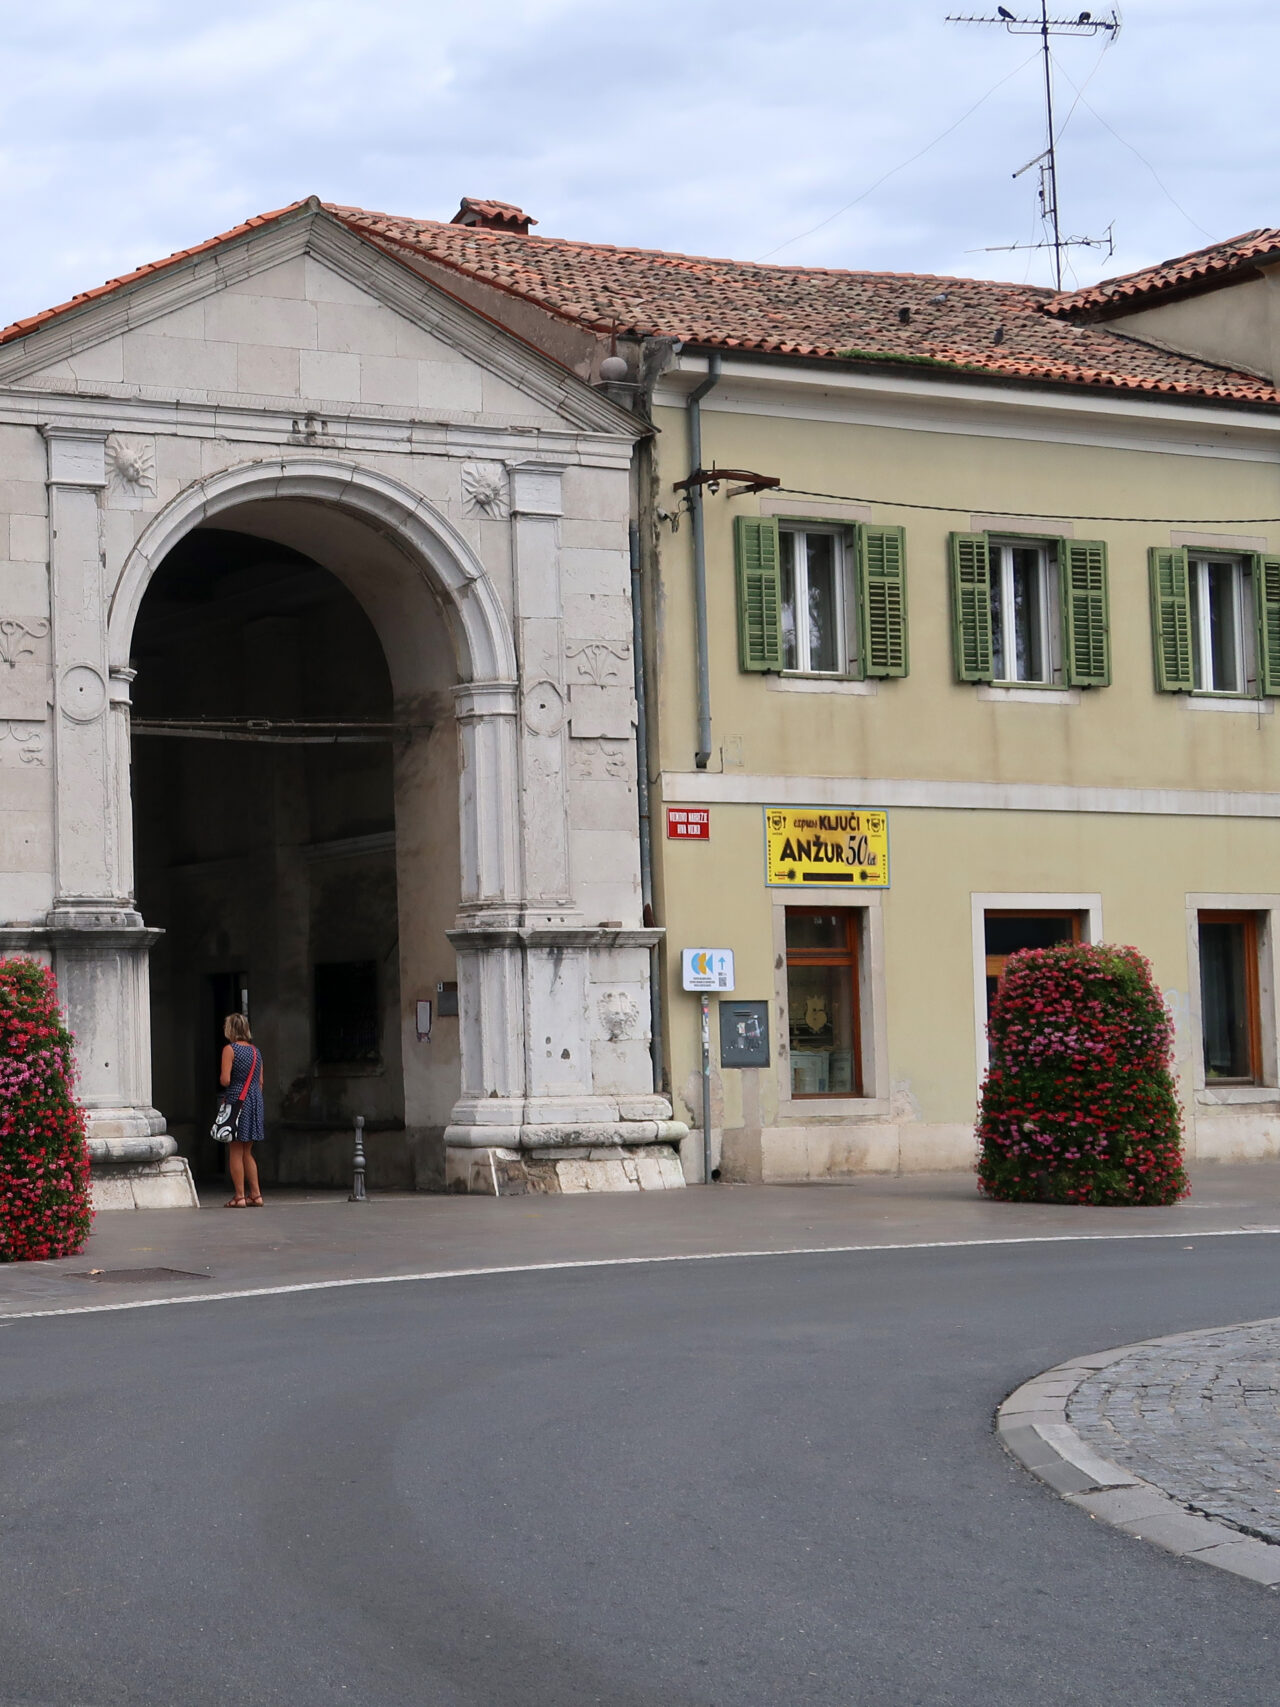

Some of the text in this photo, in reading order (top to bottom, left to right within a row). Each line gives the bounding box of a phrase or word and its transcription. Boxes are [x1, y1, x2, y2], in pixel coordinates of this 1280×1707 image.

[819, 812, 860, 831] KLJUČI
[780, 834, 845, 863] ANŽUR
[846, 835, 868, 865] 50
